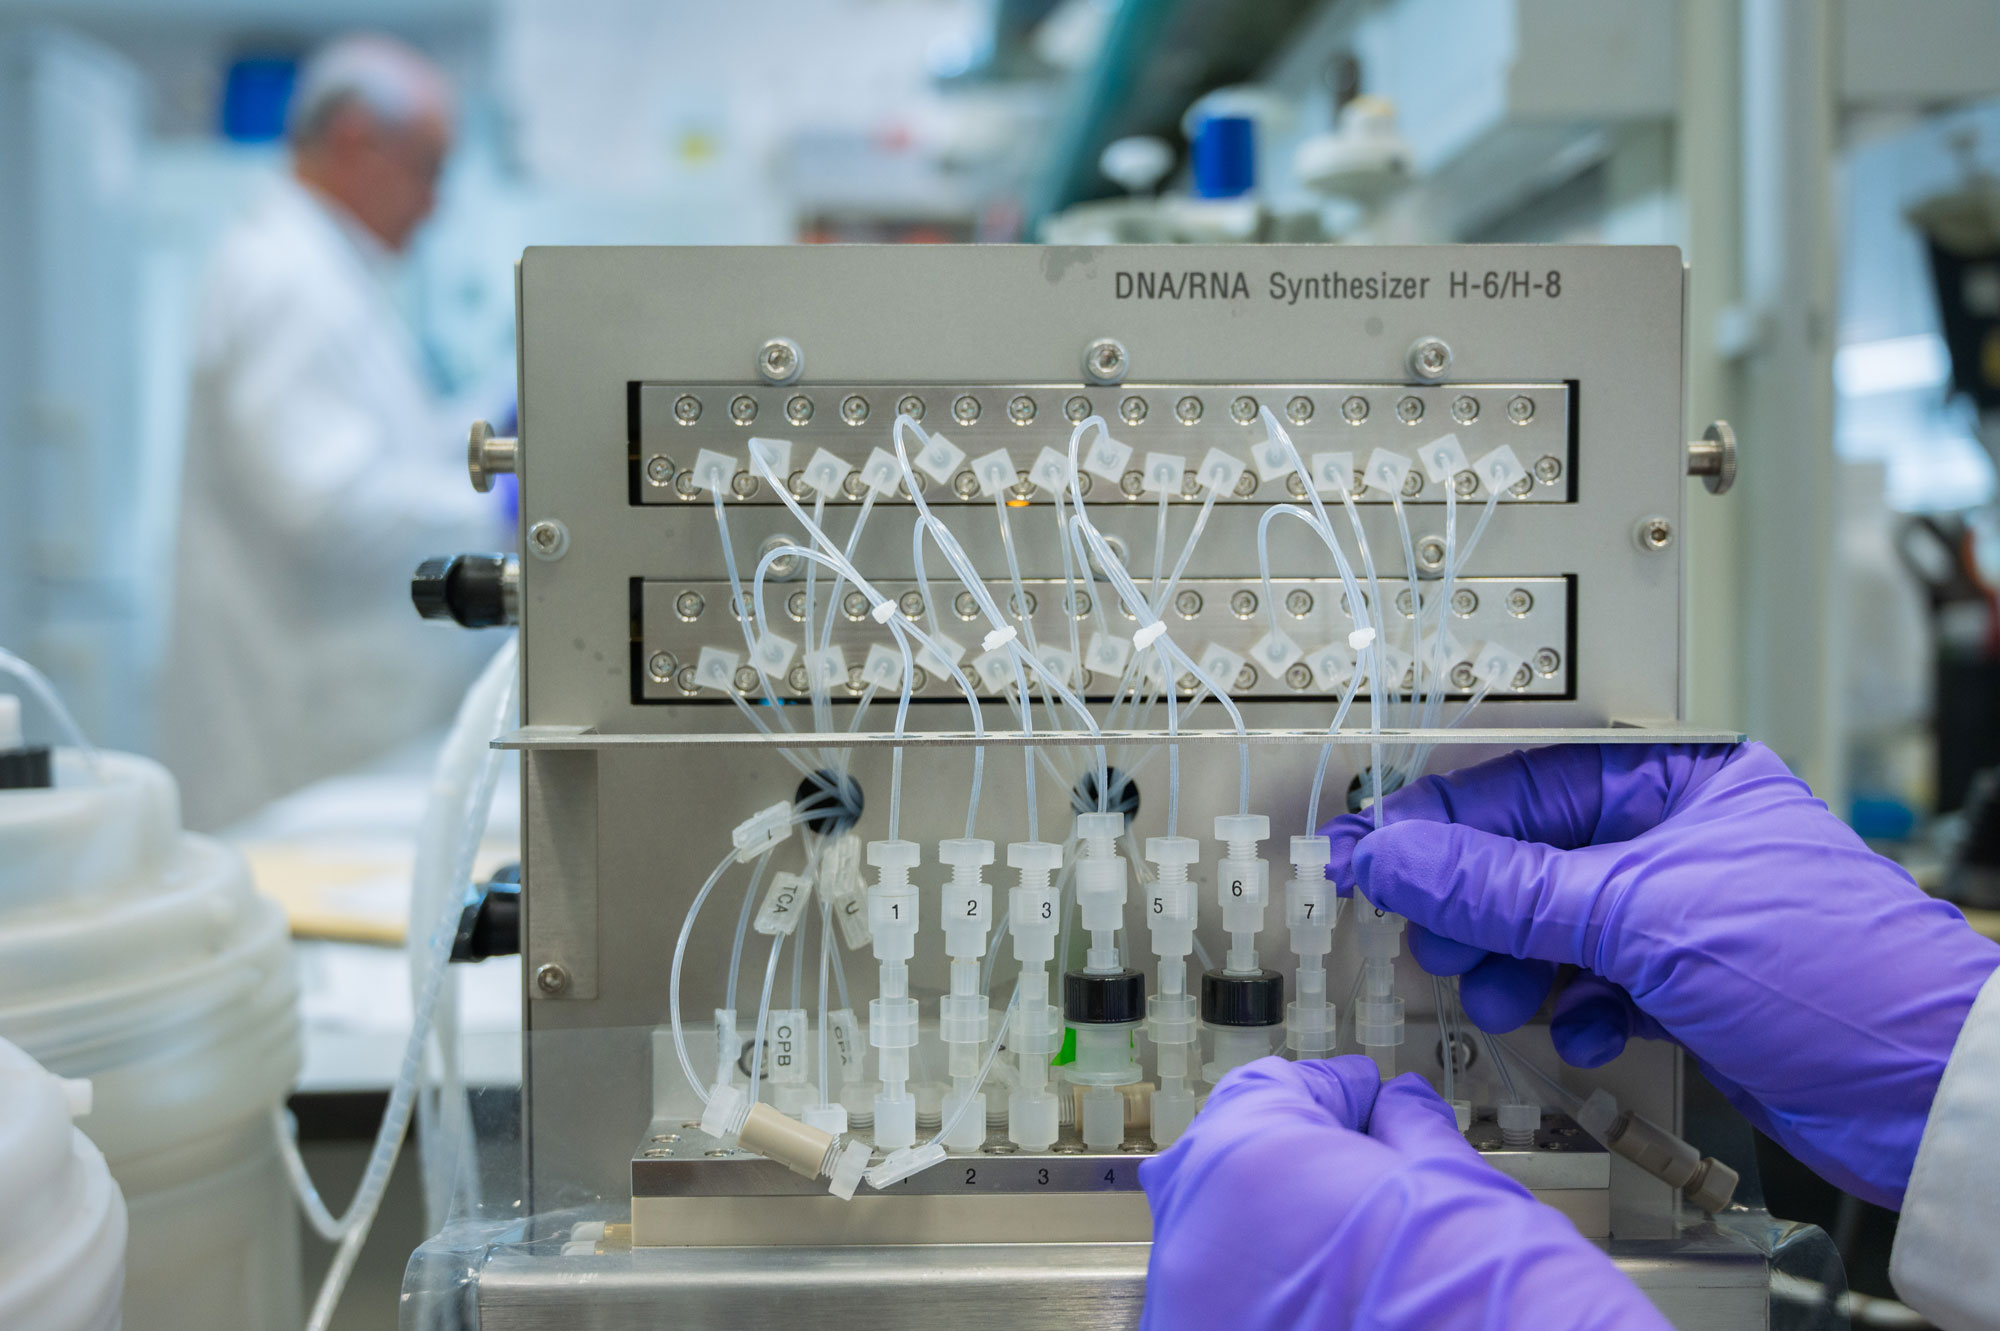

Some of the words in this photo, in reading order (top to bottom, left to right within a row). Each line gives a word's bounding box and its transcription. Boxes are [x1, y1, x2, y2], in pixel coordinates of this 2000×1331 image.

[1115, 271, 1250, 301] DNA/RNA
[1269, 271, 1430, 305] Synthesizer
[1449, 270, 1562, 300] H-6/H-8
[1231, 880, 1242, 897] 6
[773, 886, 798, 913] TCA
[967, 900, 977, 916] 2
[1153, 898, 1163, 913] 5
[892, 904, 899, 919] 1
[1041, 902, 1052, 919] 3
[1304, 904, 1315, 919] 7
[777, 1026, 792, 1066] CPB
[965, 1168, 976, 1185] 2
[1038, 1168, 1049, 1185] 3
[1104, 1168, 1115, 1184] 4
